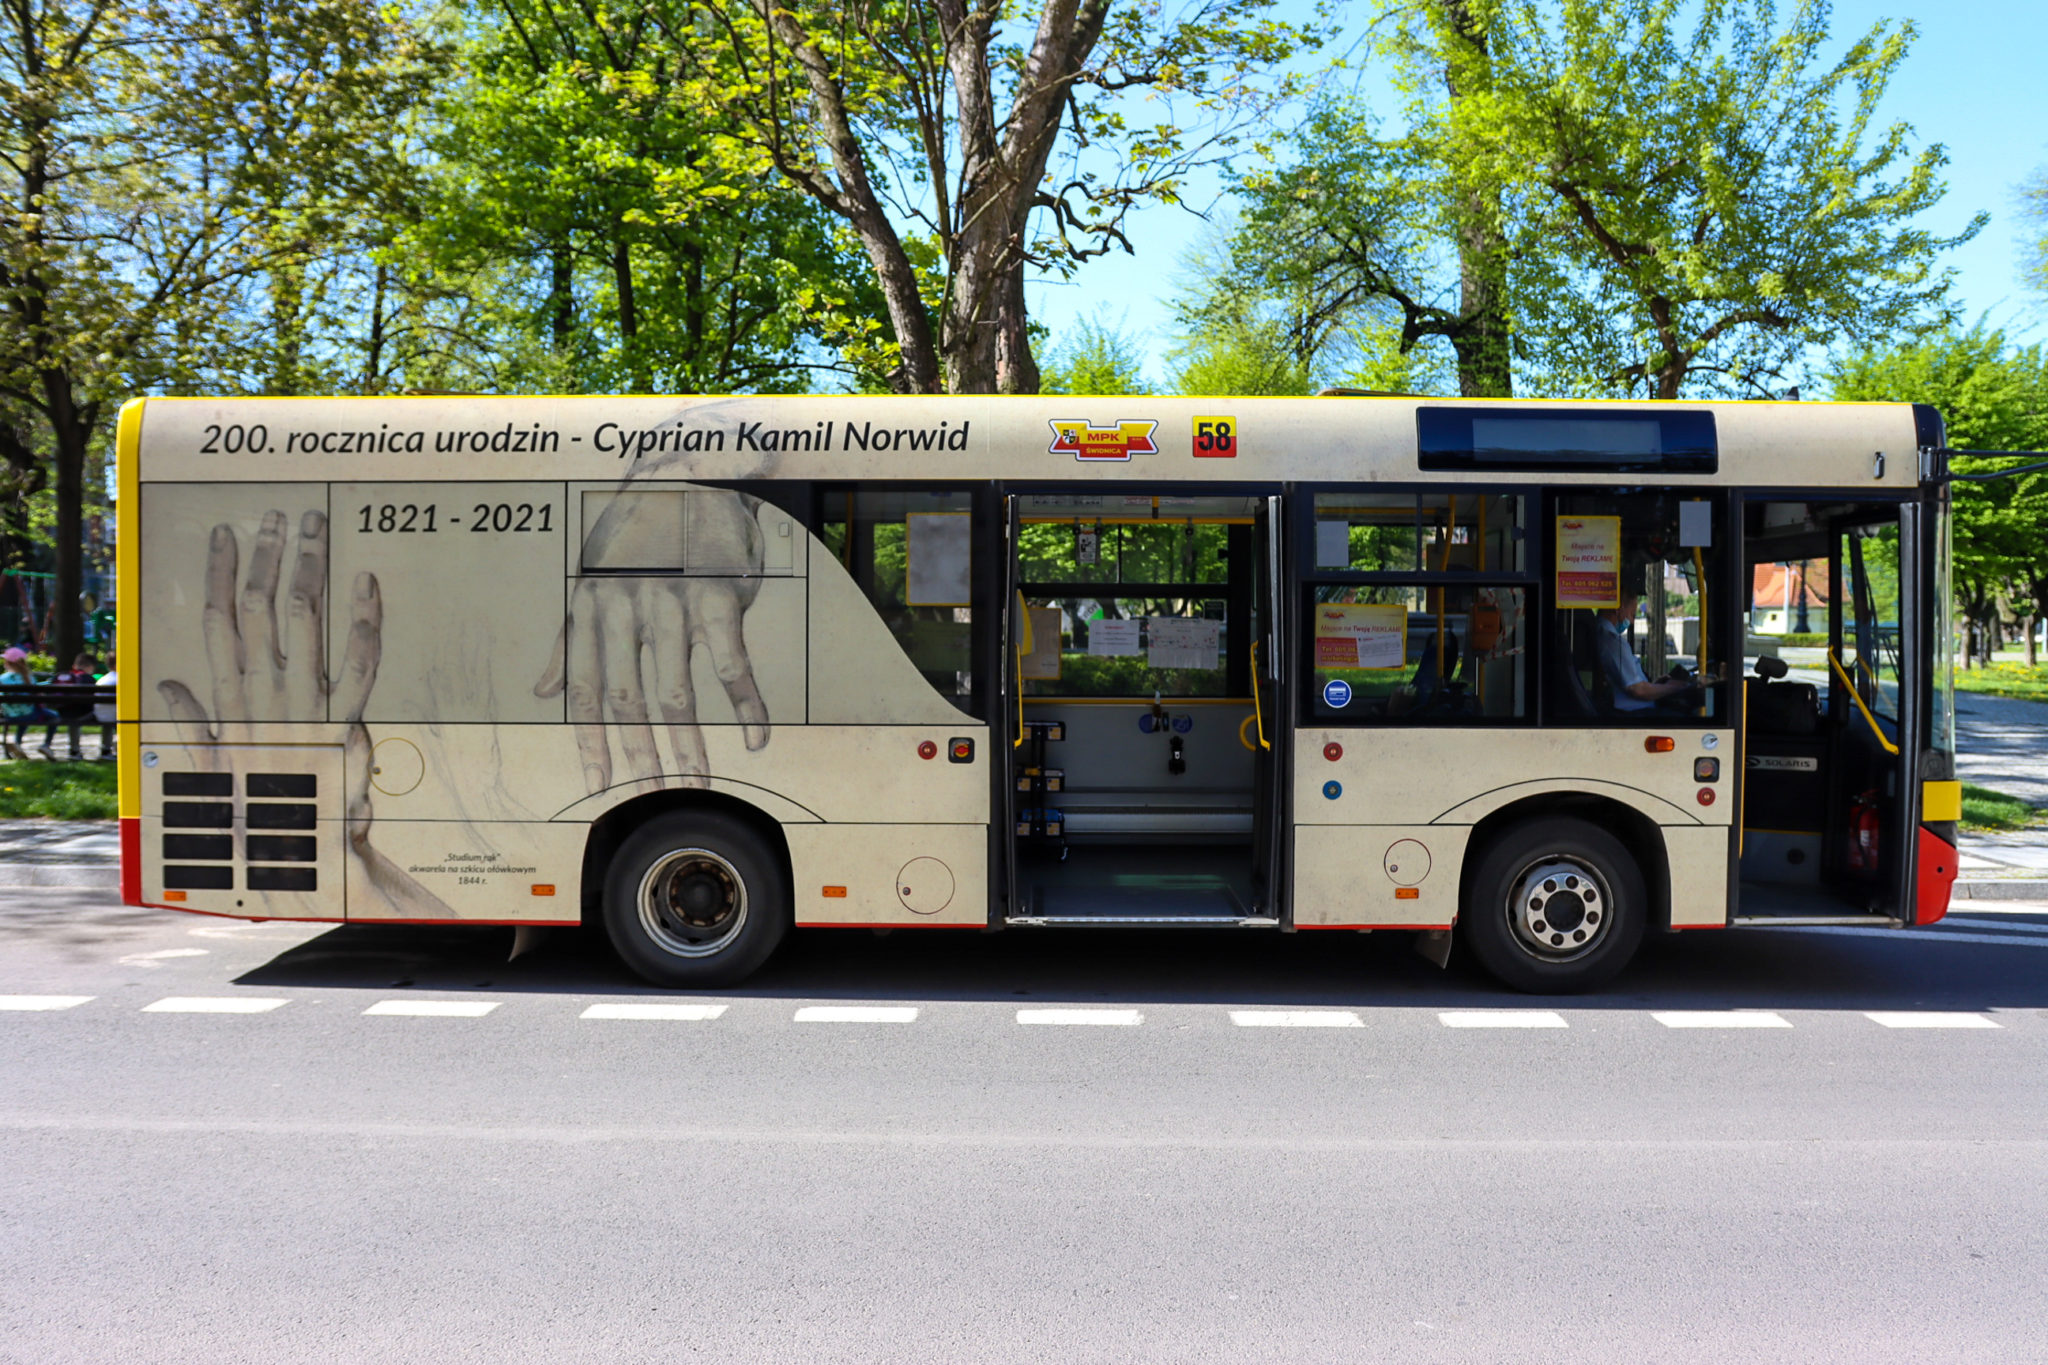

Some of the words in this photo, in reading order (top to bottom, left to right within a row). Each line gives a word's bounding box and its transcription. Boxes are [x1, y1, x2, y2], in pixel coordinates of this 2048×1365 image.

[200, 424, 275, 454] 200.
[286, 422, 425, 453] rocznica
[435, 422, 559, 453] urodzin
[594, 421, 725, 459] Cyprian
[736, 421, 833, 452] Kamil
[843, 421, 970, 452] Norwid
[1087, 432, 1119, 442] MPK
[1198, 422, 1231, 451] 58
[1086, 446, 1122, 455] ŚWIDNICA
[358, 503, 438, 534] 1821
[469, 503, 553, 534] 2021
[1765, 759, 1811, 768] SOLARIS
[408, 865, 446, 873] akwarela
[460, 865, 485, 873] szkicu
[486, 865, 537, 875] ołówkowym
[458, 876, 480, 885] 1844
